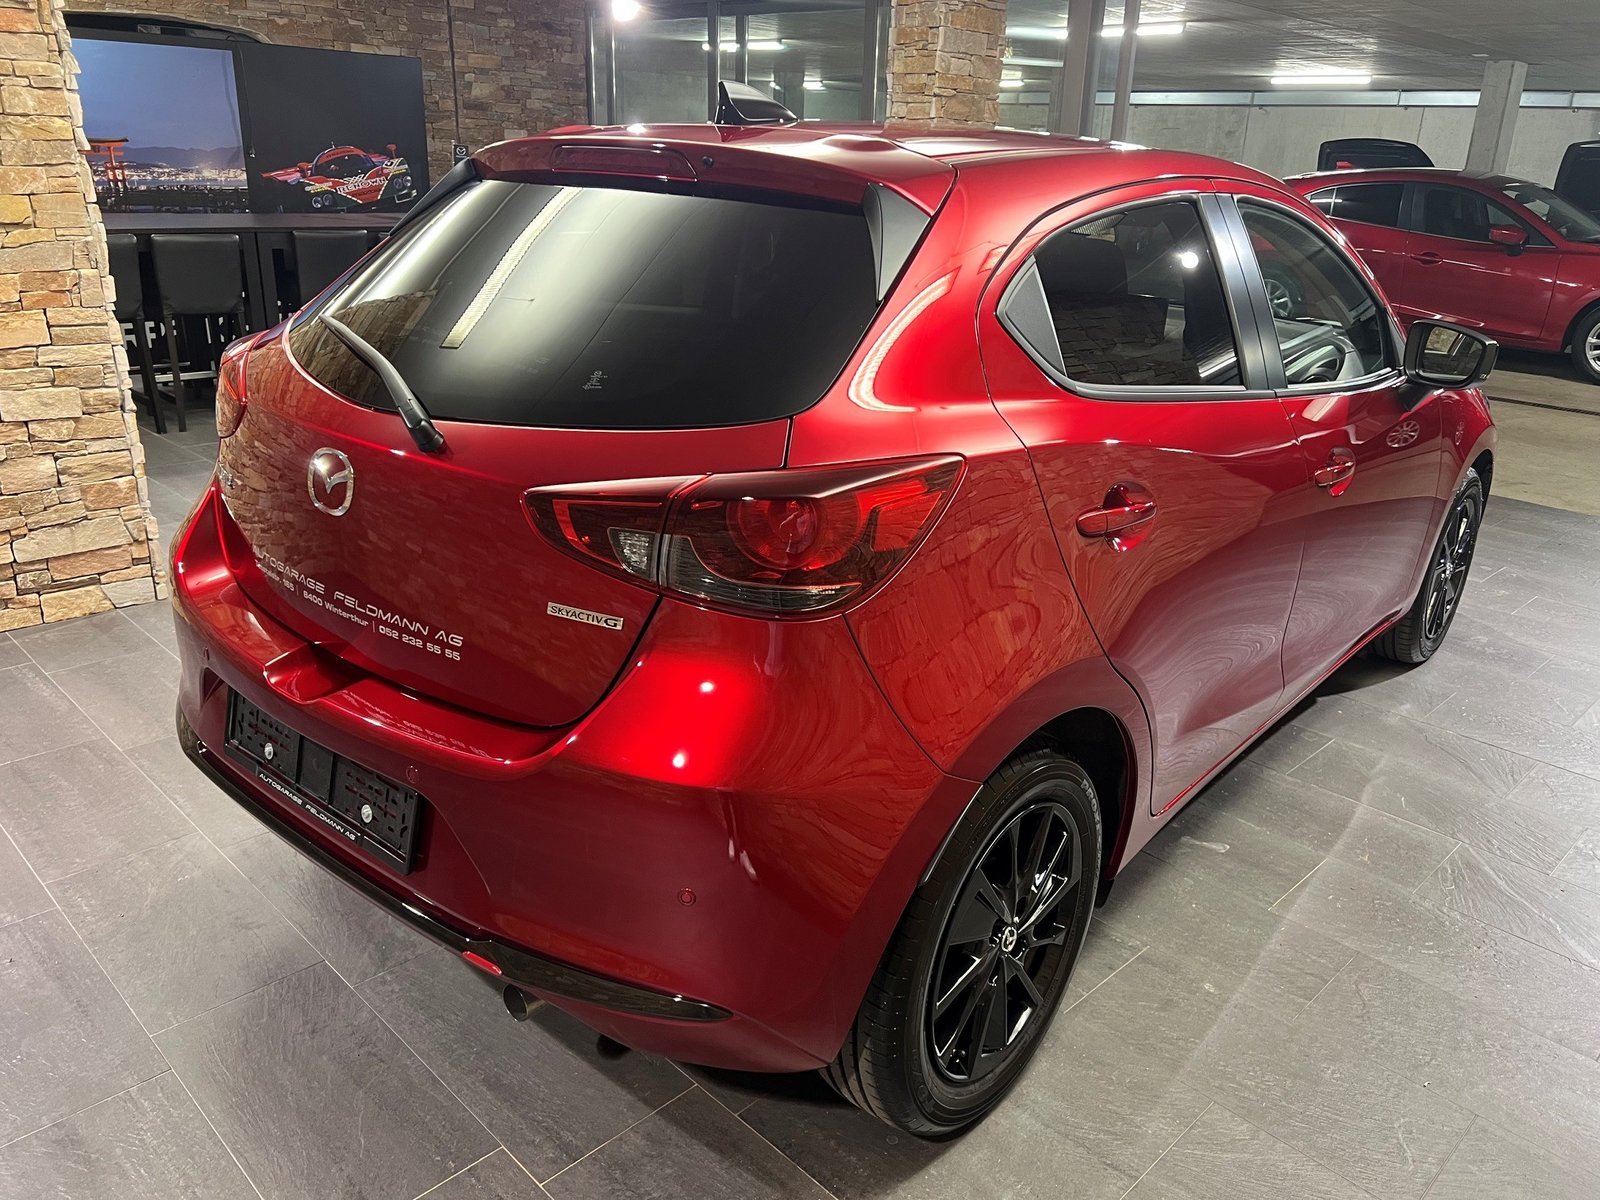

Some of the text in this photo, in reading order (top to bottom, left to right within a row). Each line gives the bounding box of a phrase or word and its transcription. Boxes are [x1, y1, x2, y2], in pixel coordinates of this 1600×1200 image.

[335, 176, 387, 194] RENOWN
[253, 545, 326, 595] AUTOGARAGE
[333, 590, 429, 636] FELDMANN
[434, 630, 464, 647] AG
[303, 590, 323, 607] 8400
[325, 600, 369, 627] Winterthur
[378, 624, 399, 640] 052
[402, 633, 423, 649] 232
[426, 641, 441, 655] 55
[444, 648, 461, 662] 55
[259, 773, 356, 841] AUTOGARAGE FELDMANN AG
